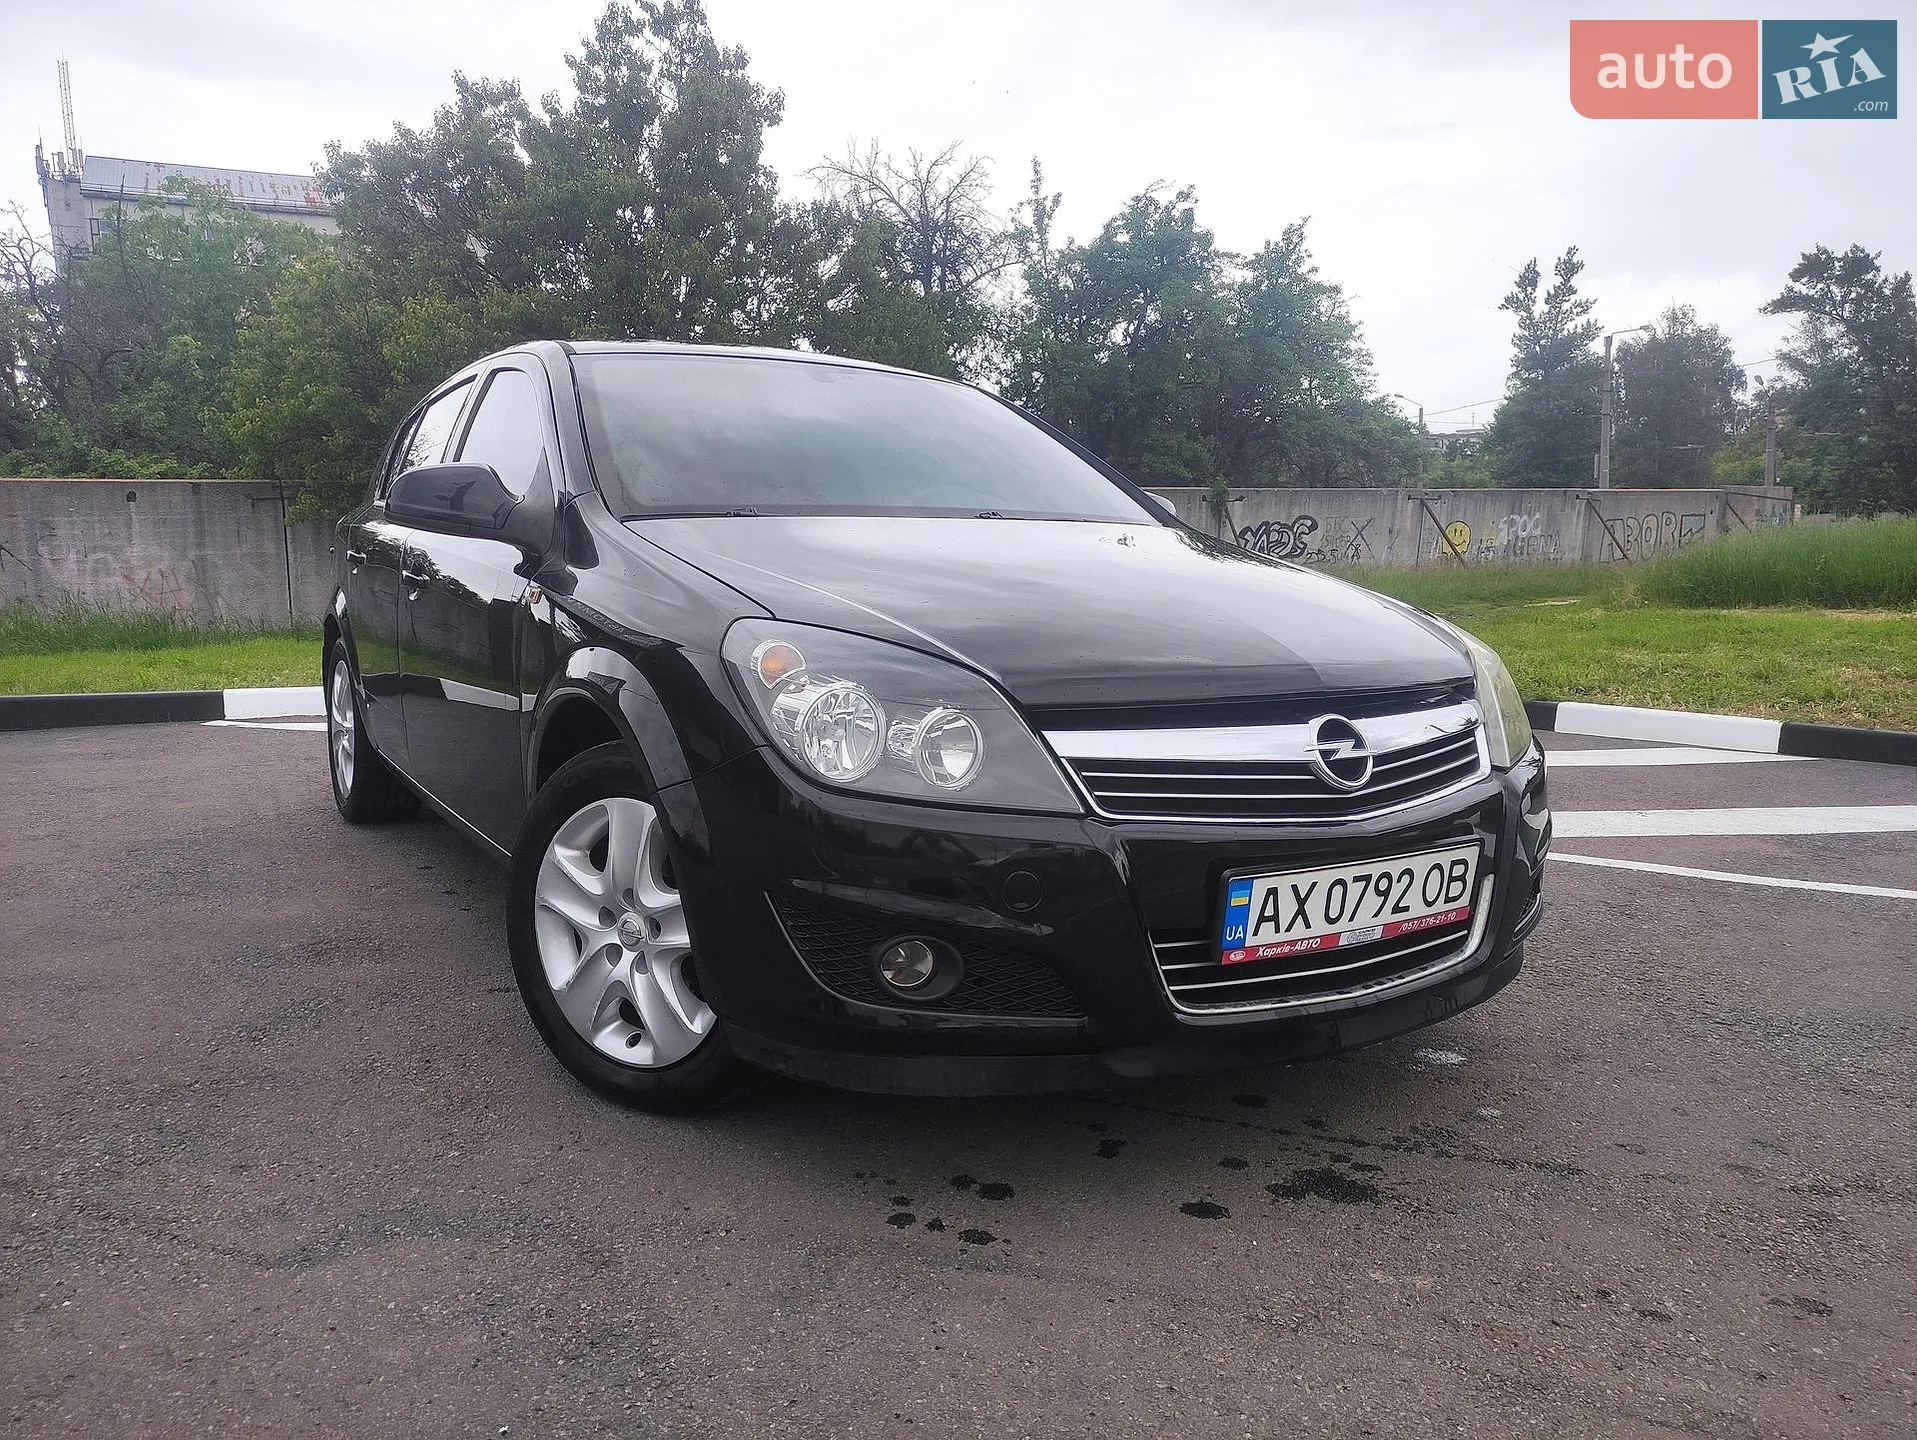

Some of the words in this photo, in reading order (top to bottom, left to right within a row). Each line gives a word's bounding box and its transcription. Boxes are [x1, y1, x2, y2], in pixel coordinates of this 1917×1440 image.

[1252, 880, 1318, 937] AX
[1323, 867, 1415, 926] 0792
[1421, 857, 1470, 908] OB
[1226, 924, 1244, 941] UA
